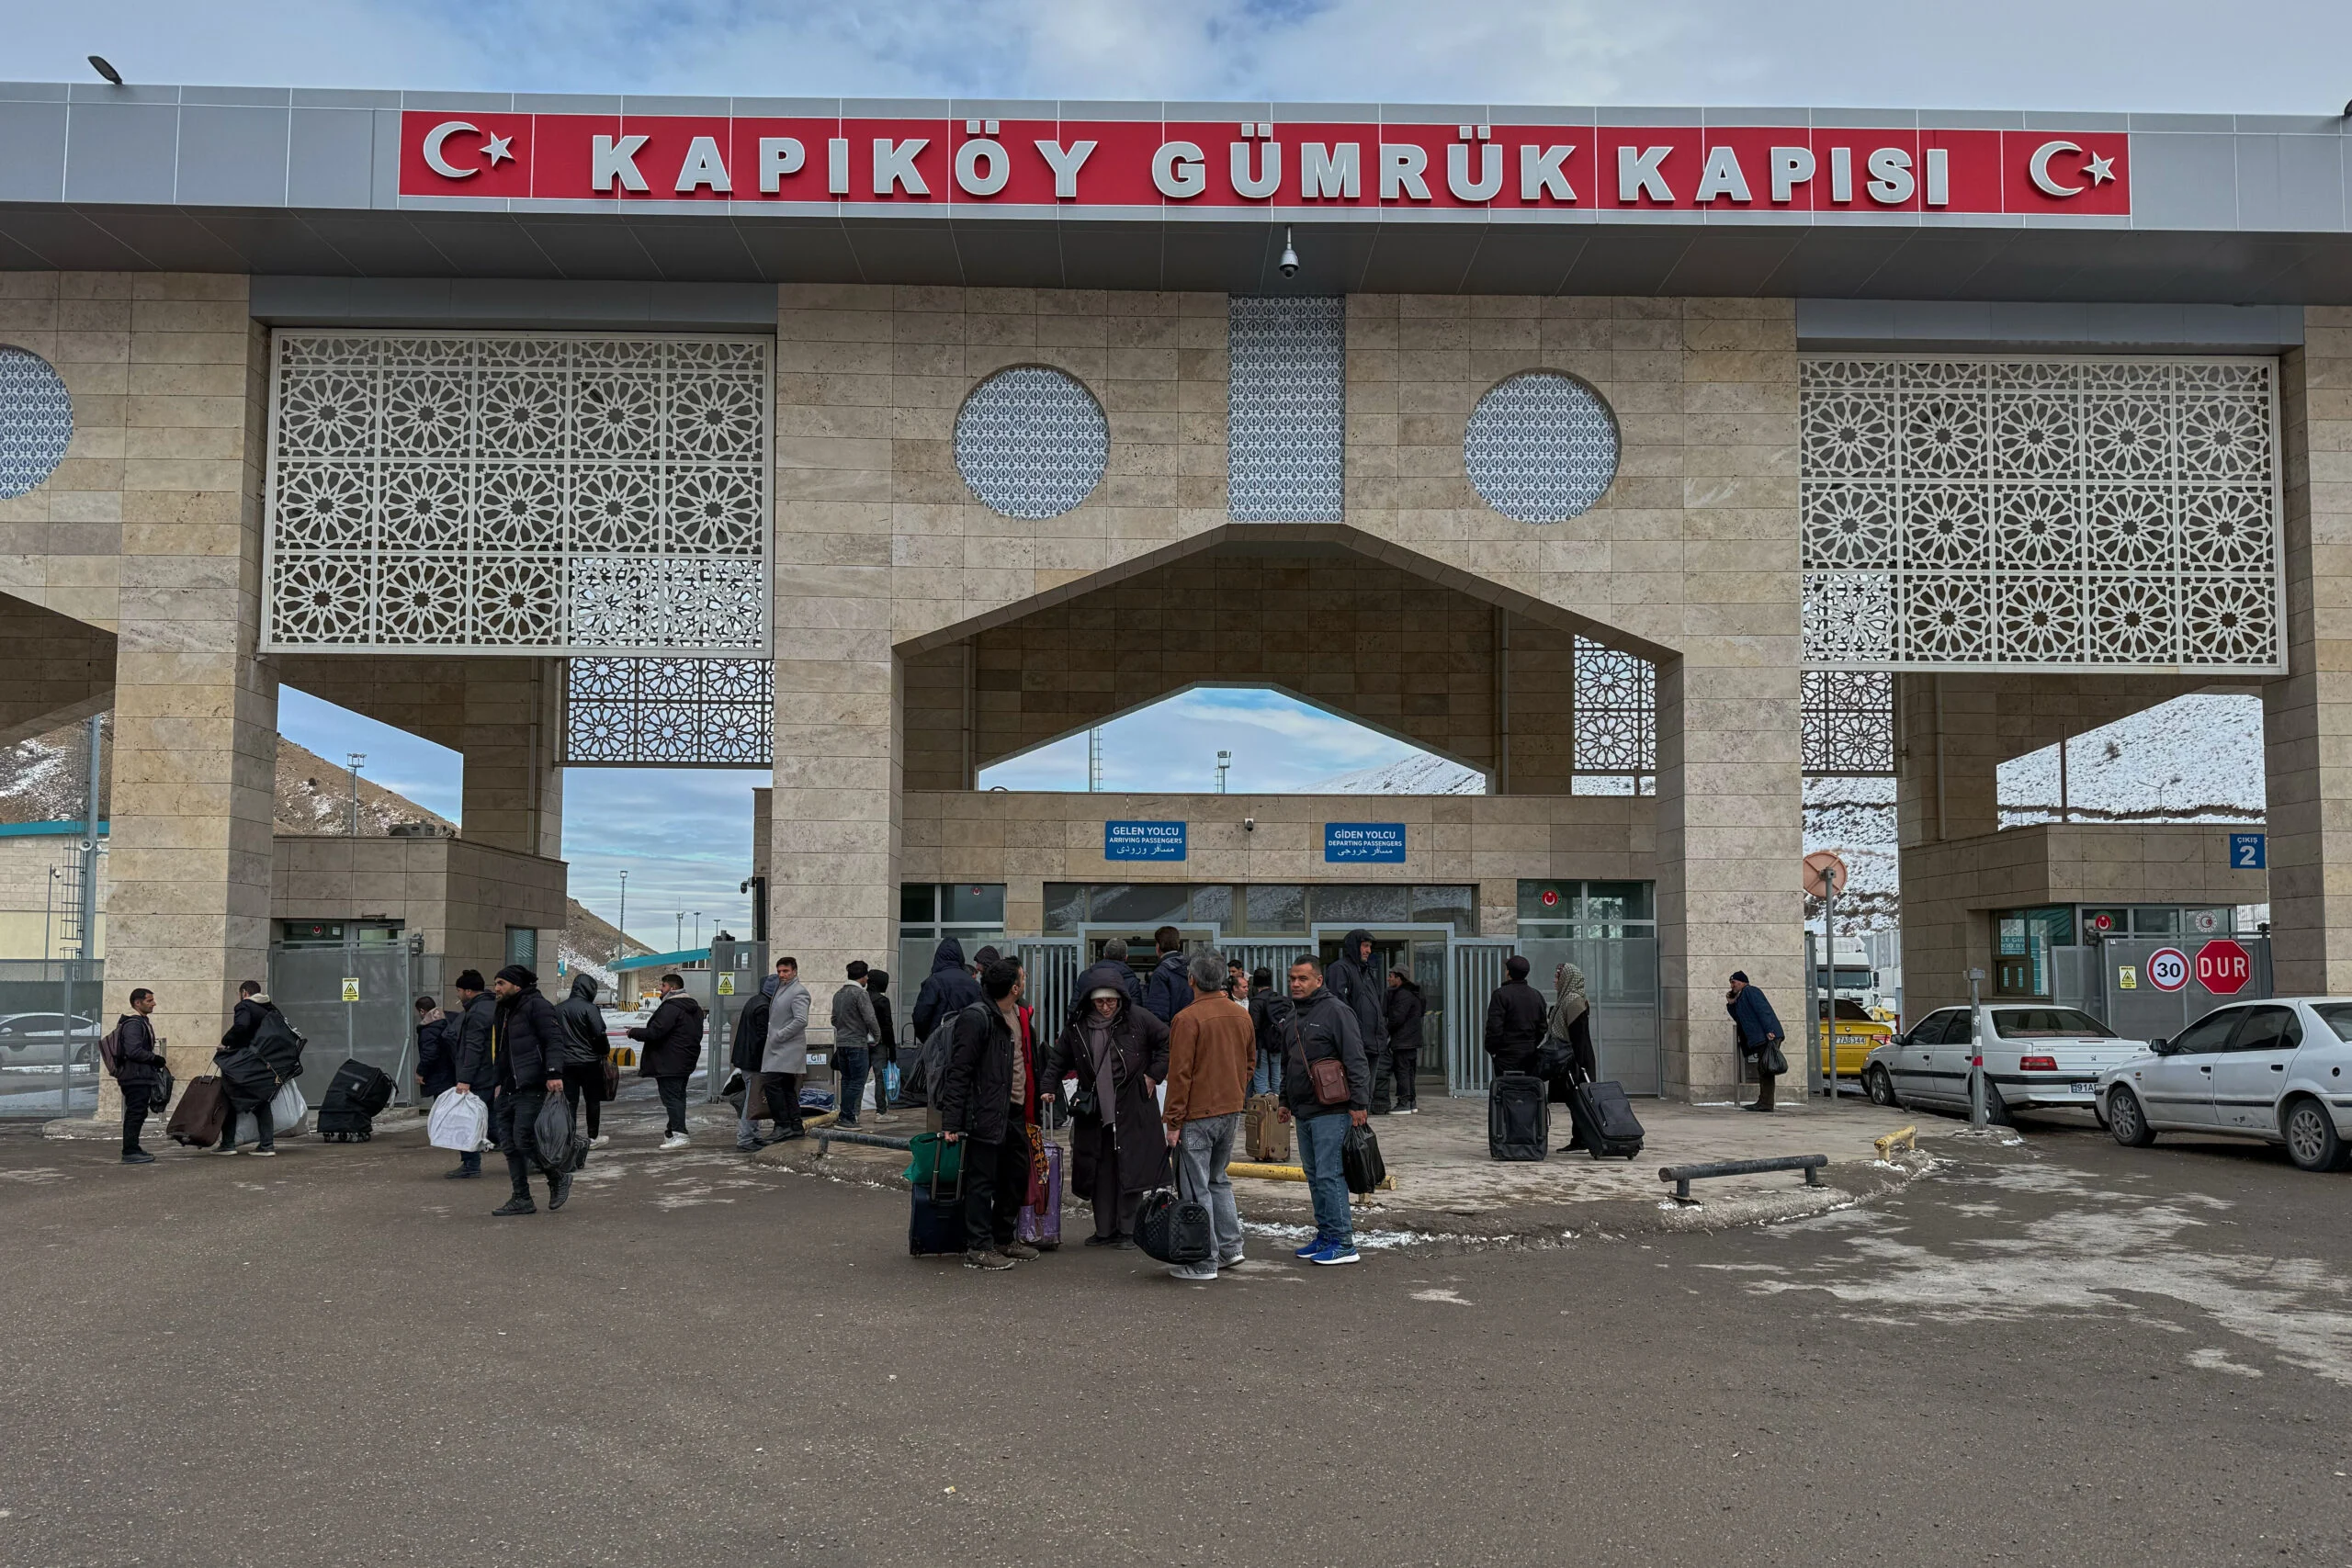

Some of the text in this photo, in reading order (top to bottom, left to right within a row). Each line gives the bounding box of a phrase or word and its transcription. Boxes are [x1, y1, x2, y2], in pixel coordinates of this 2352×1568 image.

[591, 118, 1950, 206] KAPIKÖY GÜMRÜK KAPISI
[1113, 827, 1179, 836] GELEN YOLCU
[1334, 829, 1396, 840] GİDEN YOLCU
[1150, 844, 1175, 855] مسافر
[1371, 846, 1394, 856] مسافر
[2239, 845, 2256, 865] 2
[2156, 963, 2181, 978] 30
[2199, 956, 2246, 978] DUR
[2076, 1083, 2096, 1092] 91A
